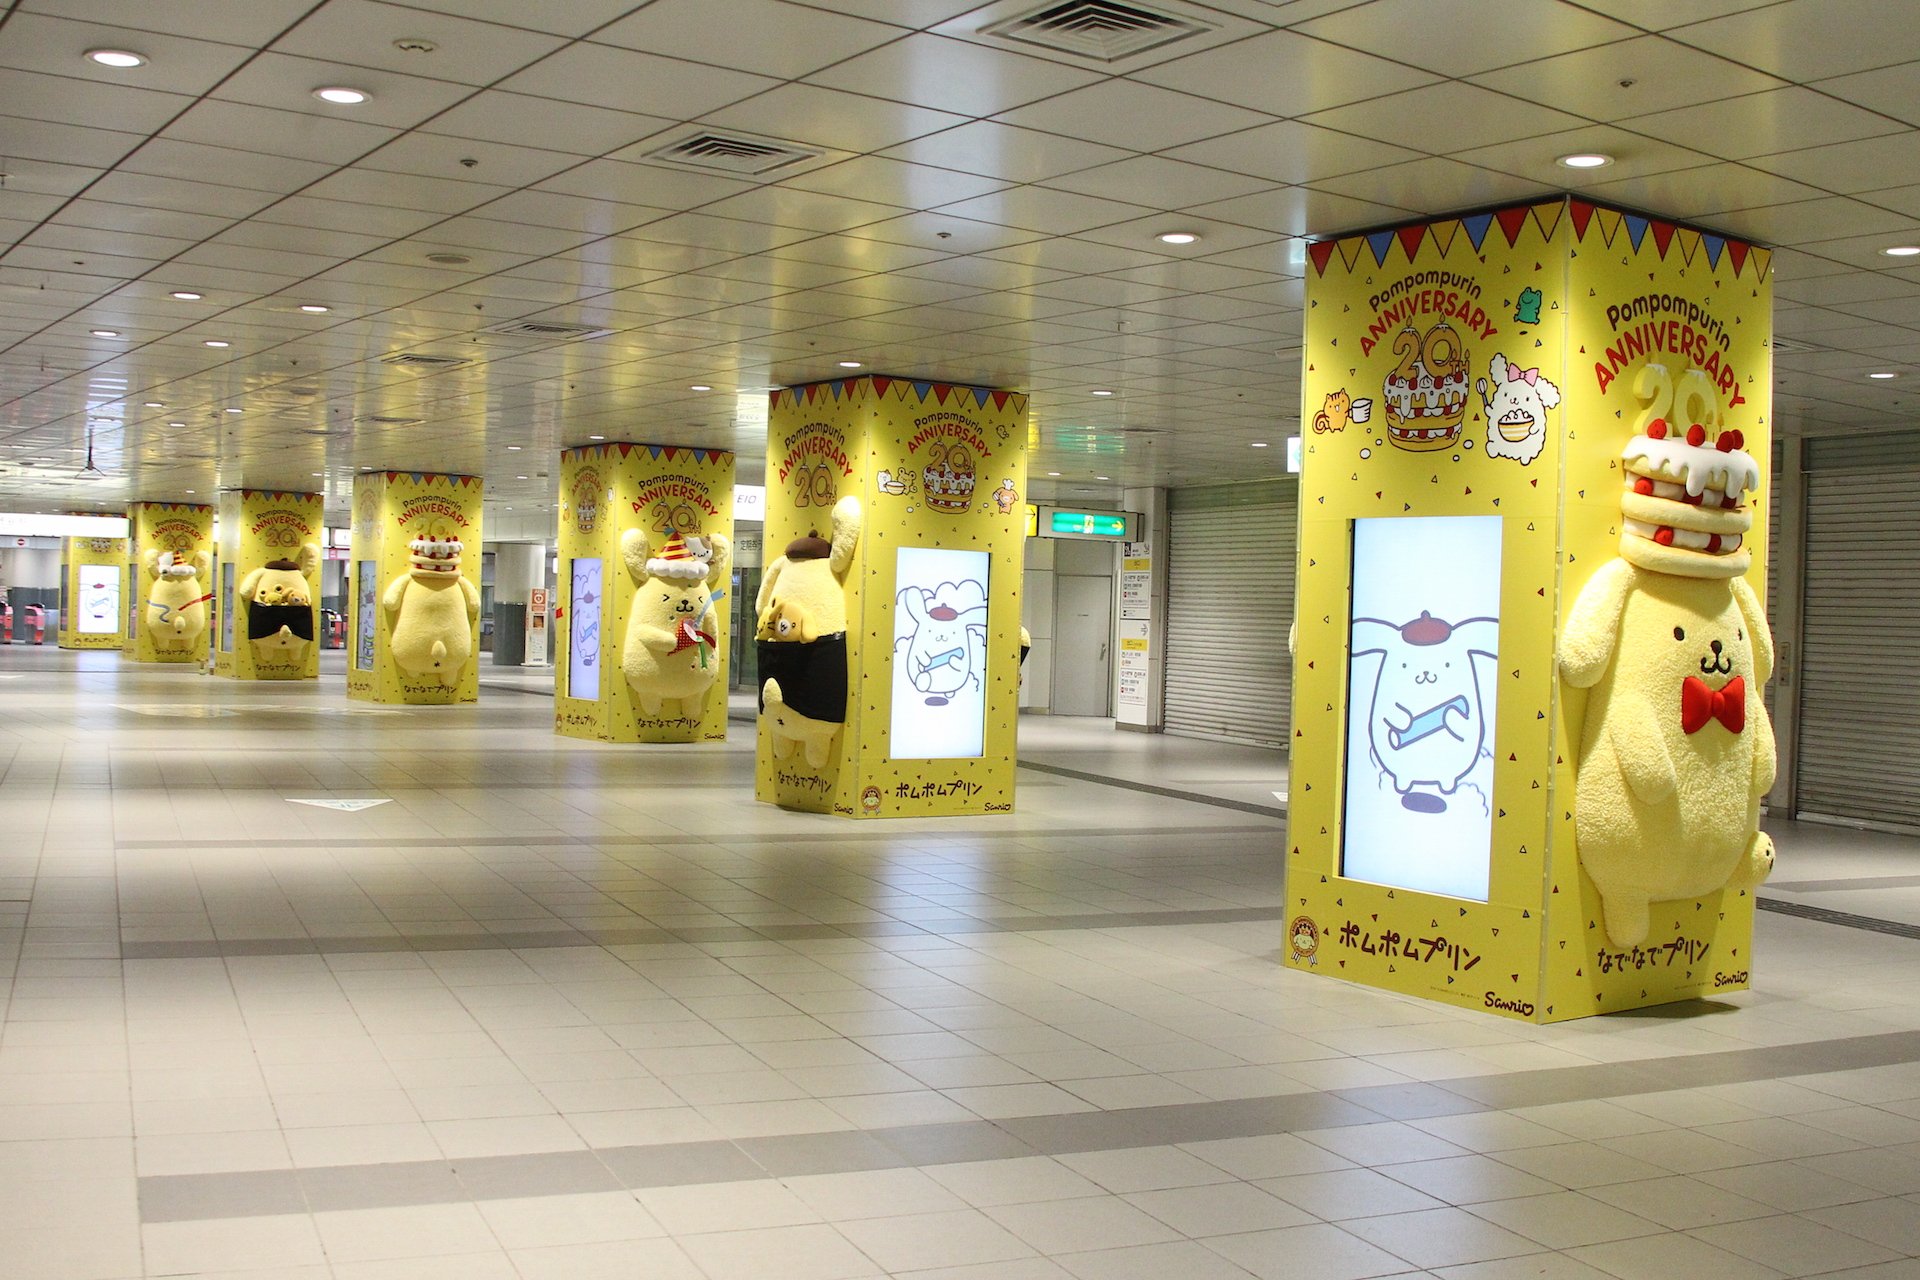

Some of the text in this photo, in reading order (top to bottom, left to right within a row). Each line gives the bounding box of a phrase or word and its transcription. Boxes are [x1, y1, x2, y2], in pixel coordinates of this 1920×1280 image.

[1369, 270, 1481, 312] Pompompurin
[1360, 290, 1498, 357] ANNIVERSARY
[1606, 294, 1730, 352] Pompompurin
[1594, 320, 1745, 409] ANNIVERSARY
[914, 412, 983, 435] Pompompurin
[908, 423, 992, 458] ANNIVERSARY
[778, 435, 853, 484] ANNIVERSARY
[632, 484, 718, 516] ANNIVERSARY
[251, 516, 312, 535] ANNIVERSARY
[397, 503, 470, 528] ANNIVERSARY
[152, 523, 204, 541] ANNIVERSARY
[637, 717, 701, 729] なでなでプリン
[777, 769, 832, 793] なでなでプリン
[896, 779, 982, 800] ポムポムプリン
[984, 801, 1011, 812] Sanrio
[1340, 920, 1480, 971] ポムポムプリン
[1597, 936, 1710, 974] なでなでプリン
[1715, 970, 1748, 987] Sanrio
[1484, 991, 1534, 1017] Sanrio
